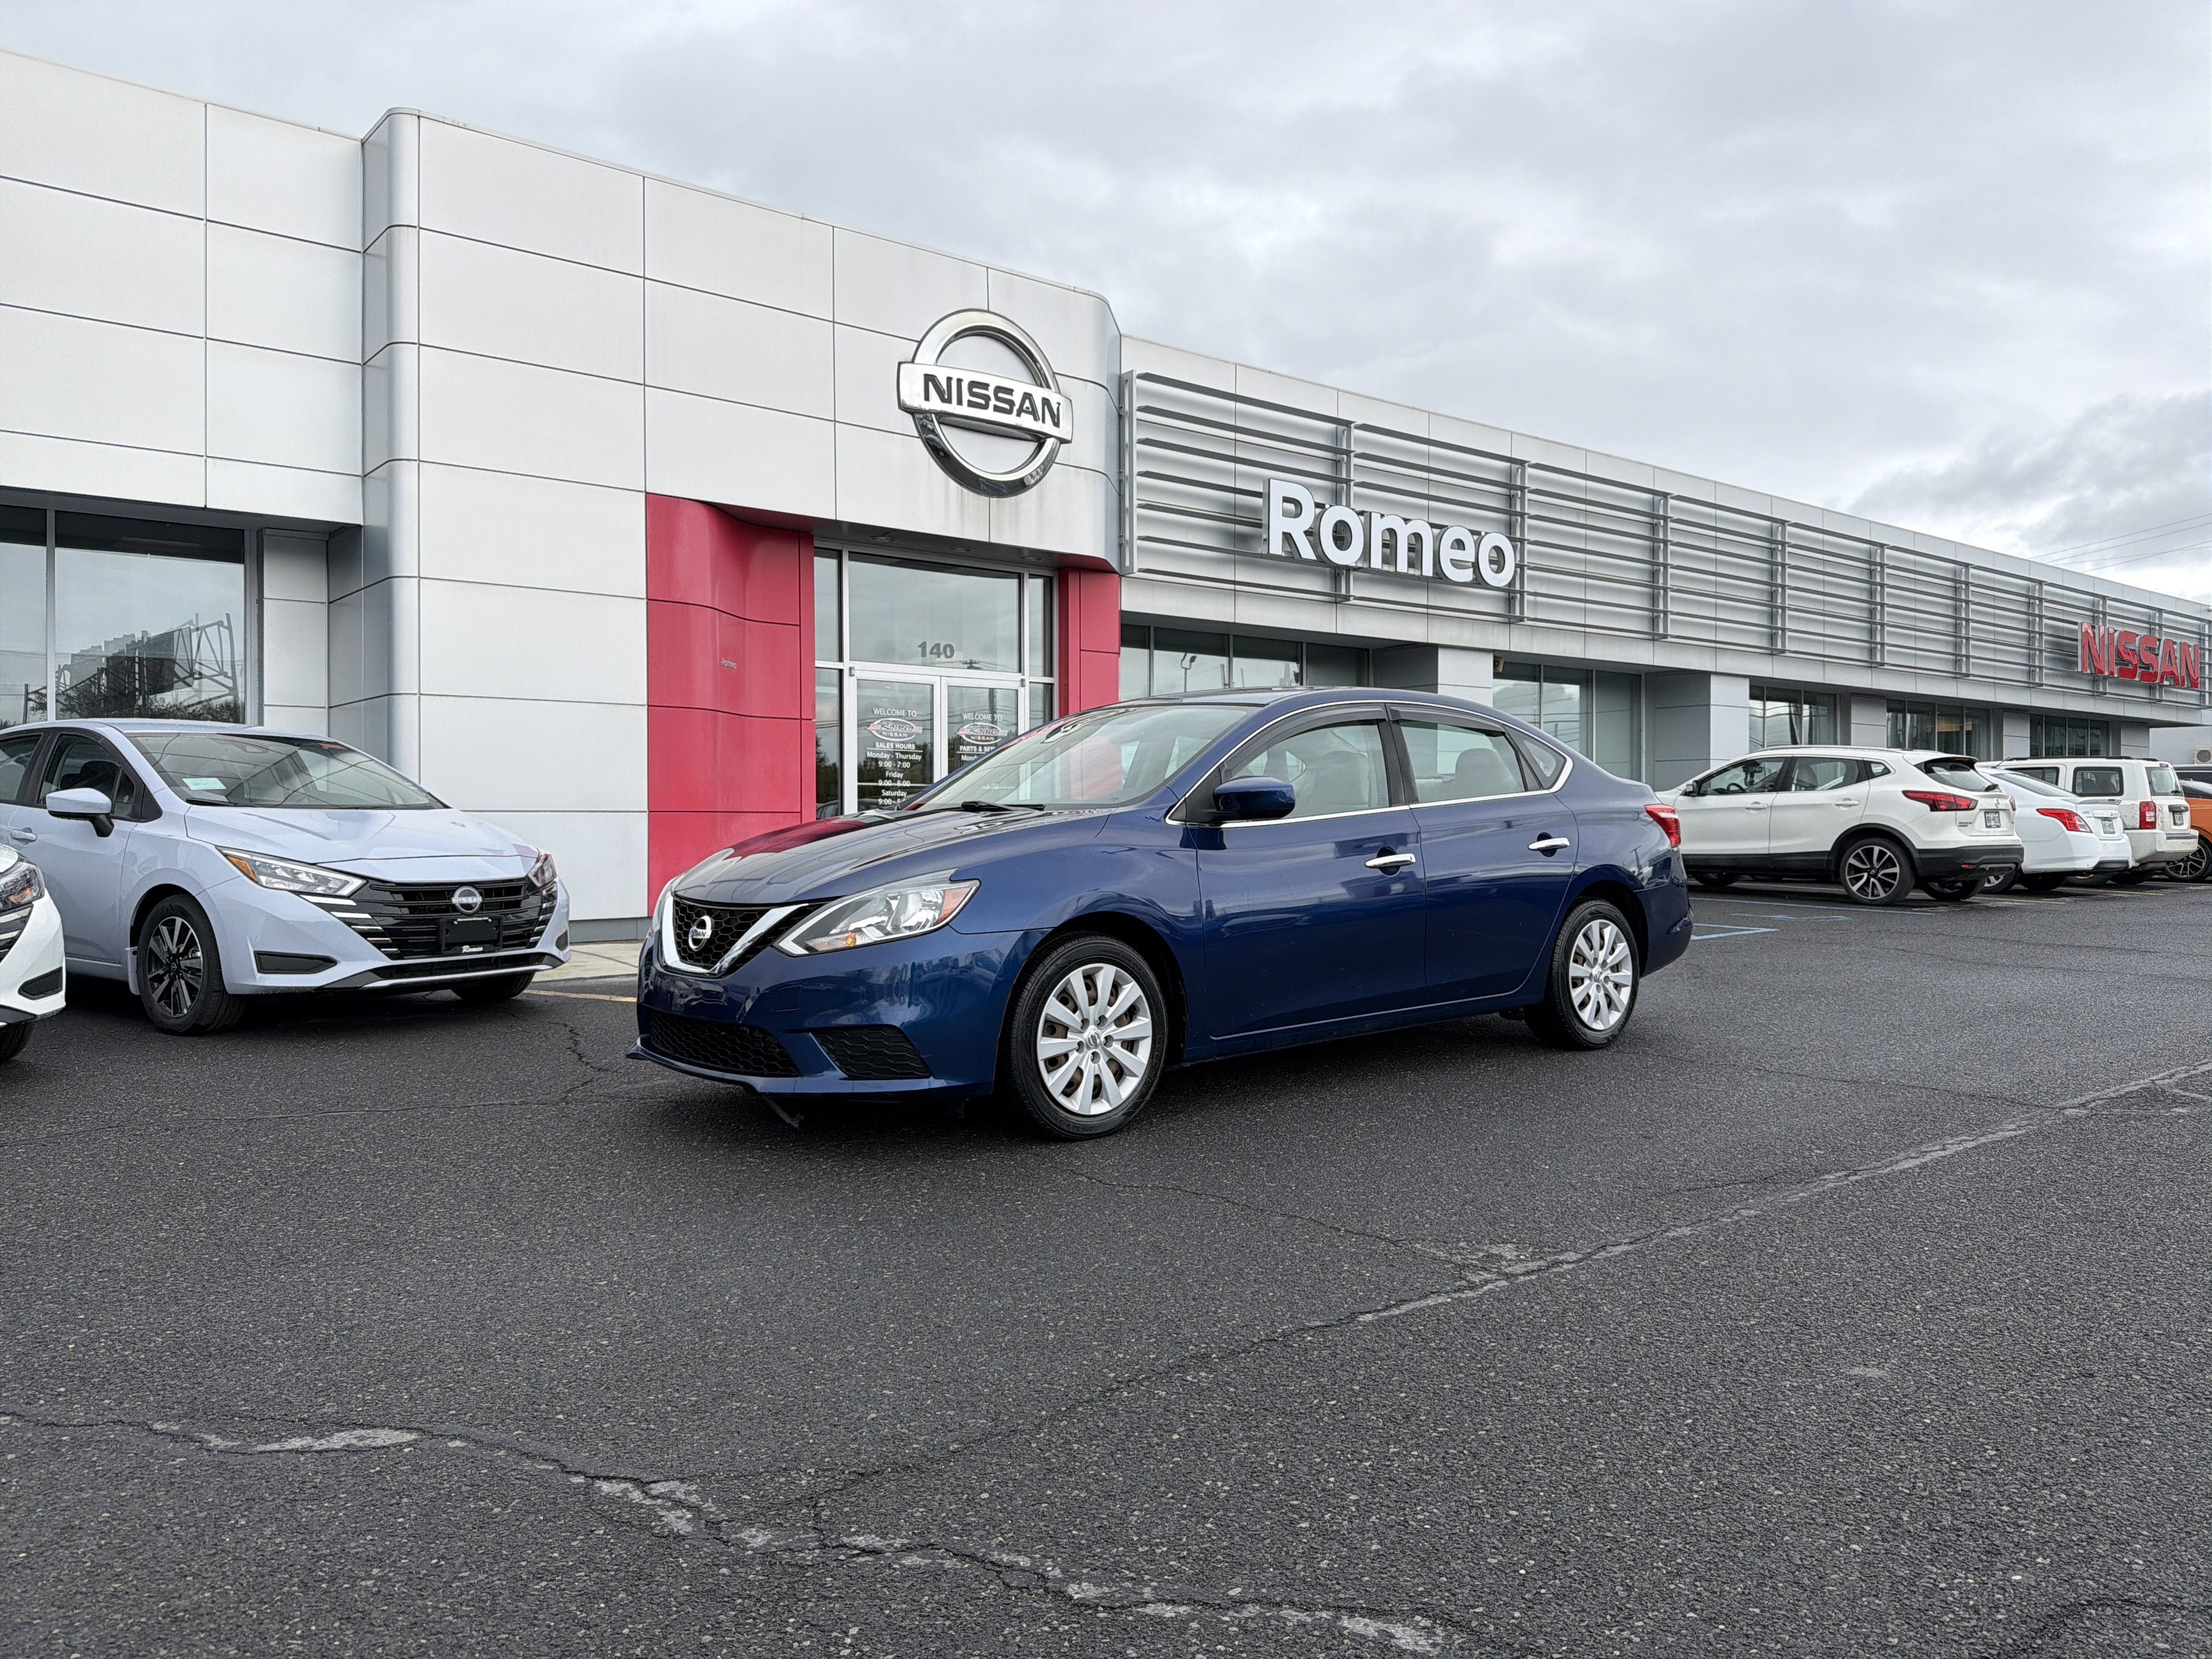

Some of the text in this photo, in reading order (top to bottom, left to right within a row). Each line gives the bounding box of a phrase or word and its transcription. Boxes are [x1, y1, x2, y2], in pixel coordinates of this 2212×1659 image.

[923, 373, 1061, 428] NISSAN
[1263, 478, 1515, 587] Romeo
[917, 641, 955, 659] 140
[2079, 622, 2200, 689] NISSAN
[873, 707, 906, 716] WELCOME
[962, 713, 992, 721] WELCOME
[879, 720, 914, 732] Romeo
[968, 724, 1000, 736] Romeo
[867, 751, 890, 760] Monday
[895, 752, 922, 761] Thursday
[885, 771, 904, 779] Friday
[882, 789, 907, 798] Saturday
[462, 945, 483, 953] Romeo
